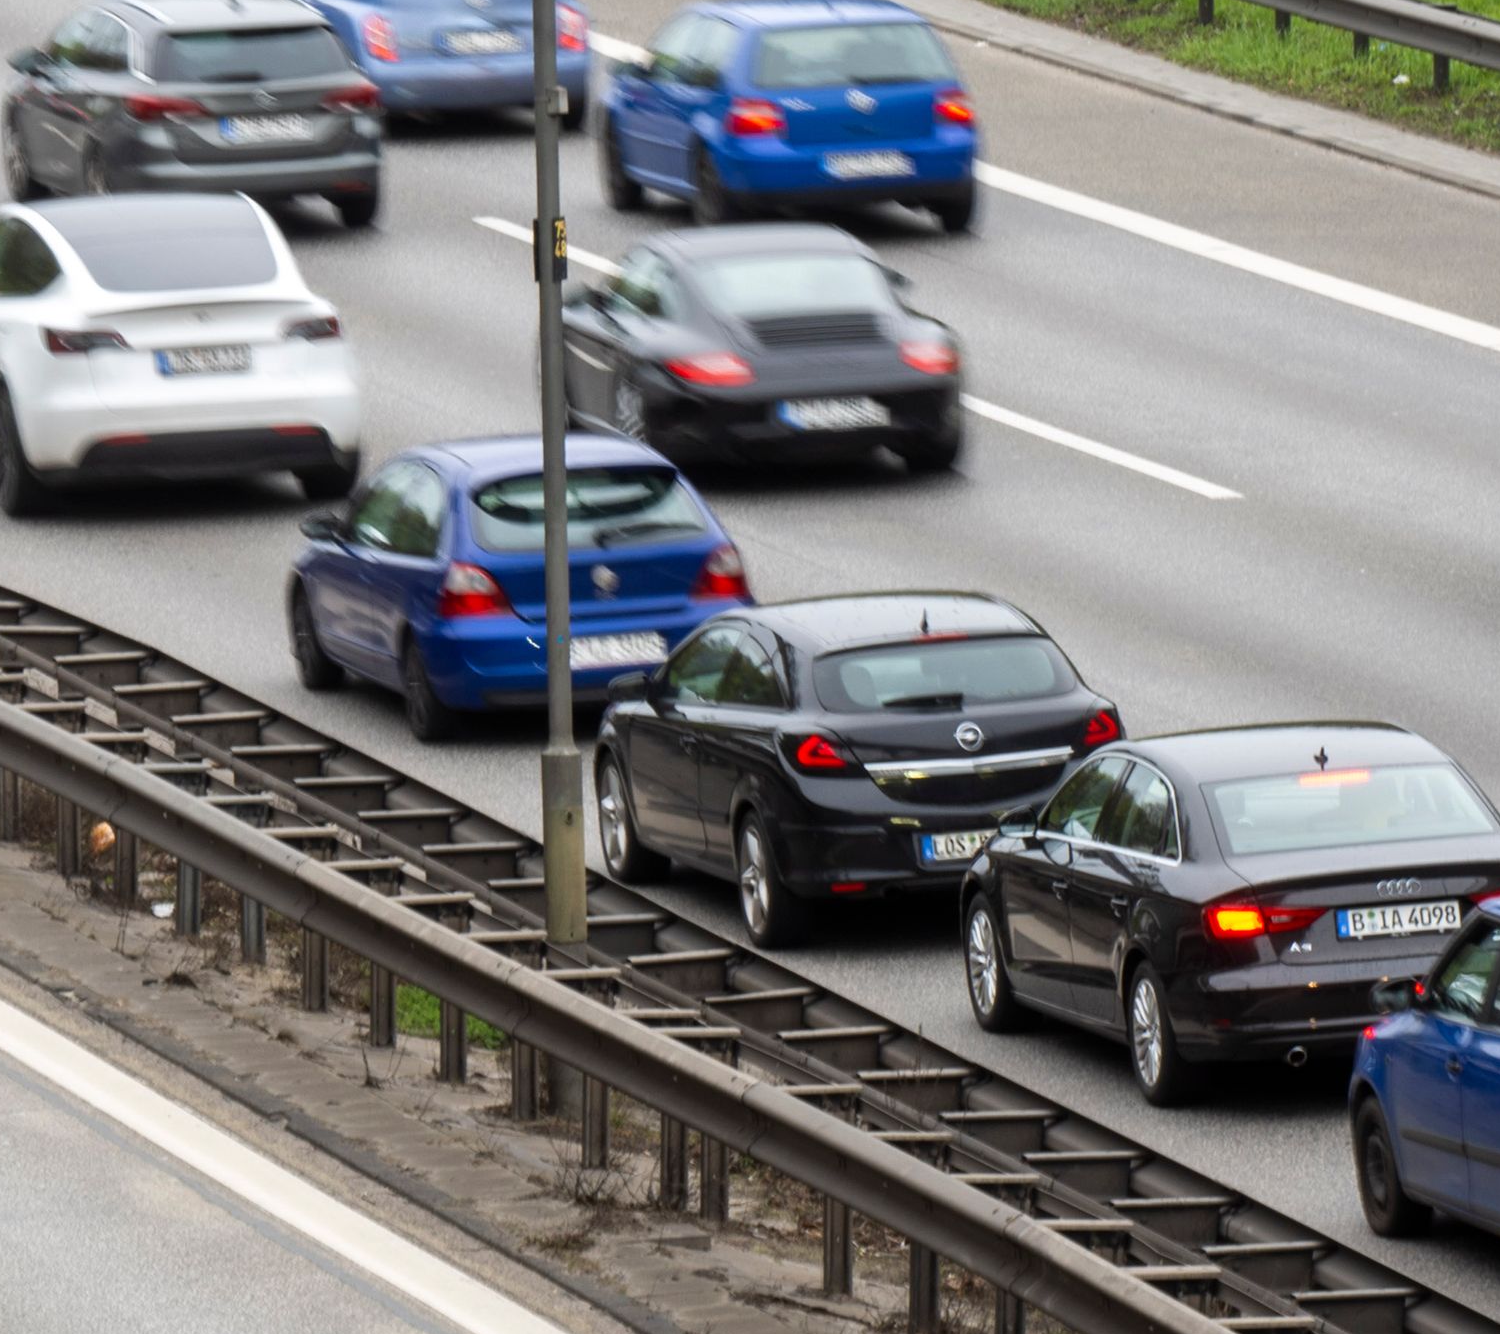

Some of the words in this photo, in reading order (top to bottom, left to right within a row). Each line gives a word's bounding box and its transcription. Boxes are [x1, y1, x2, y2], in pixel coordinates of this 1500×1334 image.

[933, 835, 967, 857] LOS
[1352, 913, 1366, 932] B
[1380, 910, 1404, 929] IA
[1408, 904, 1458, 928] 4098
